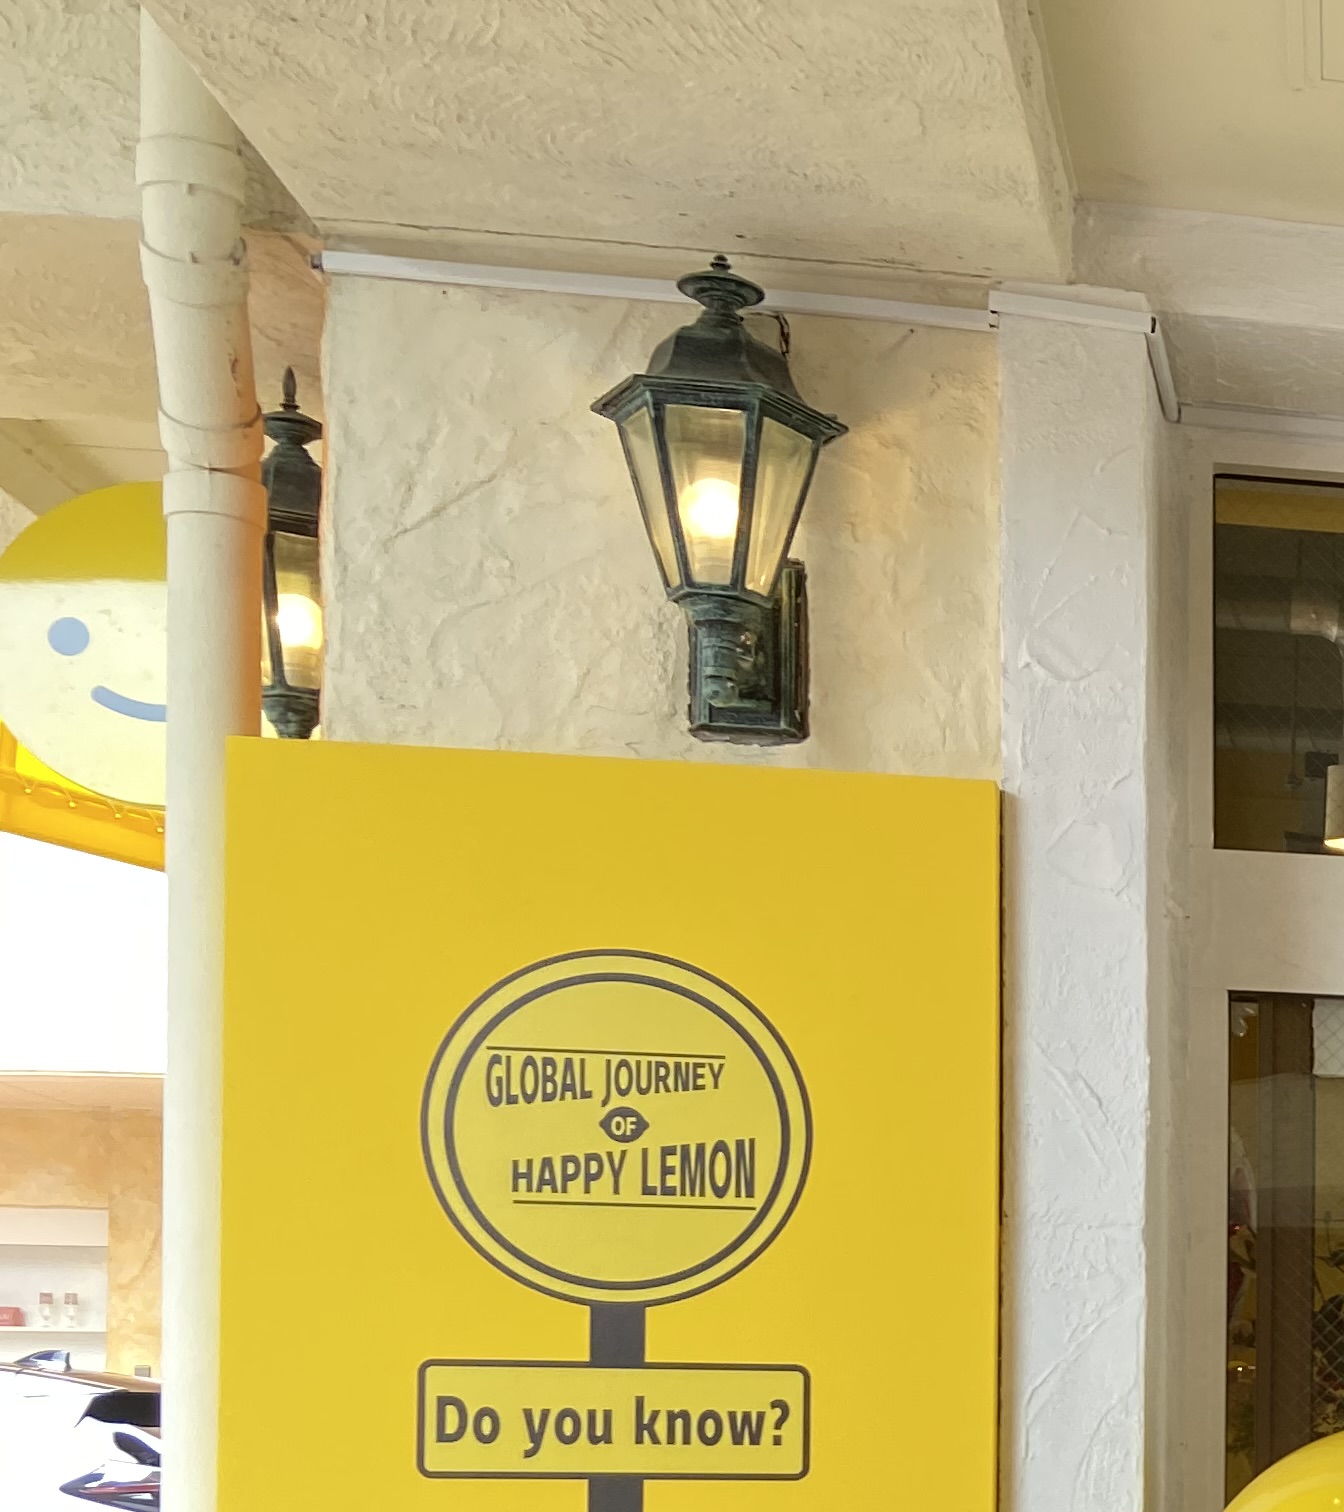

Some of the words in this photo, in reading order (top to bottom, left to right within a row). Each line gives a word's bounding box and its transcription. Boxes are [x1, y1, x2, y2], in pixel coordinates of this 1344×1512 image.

[485, 1054, 592, 1108] GLOBAL
[601, 1058, 726, 1107] JOURNEY
[611, 1115, 638, 1137] OF
[512, 1148, 627, 1196] HAPPY
[640, 1137, 757, 1199] LEMON
[435, 1394, 501, 1444] Do
[523, 1405, 613, 1458] you
[634, 1394, 791, 1446] know?
